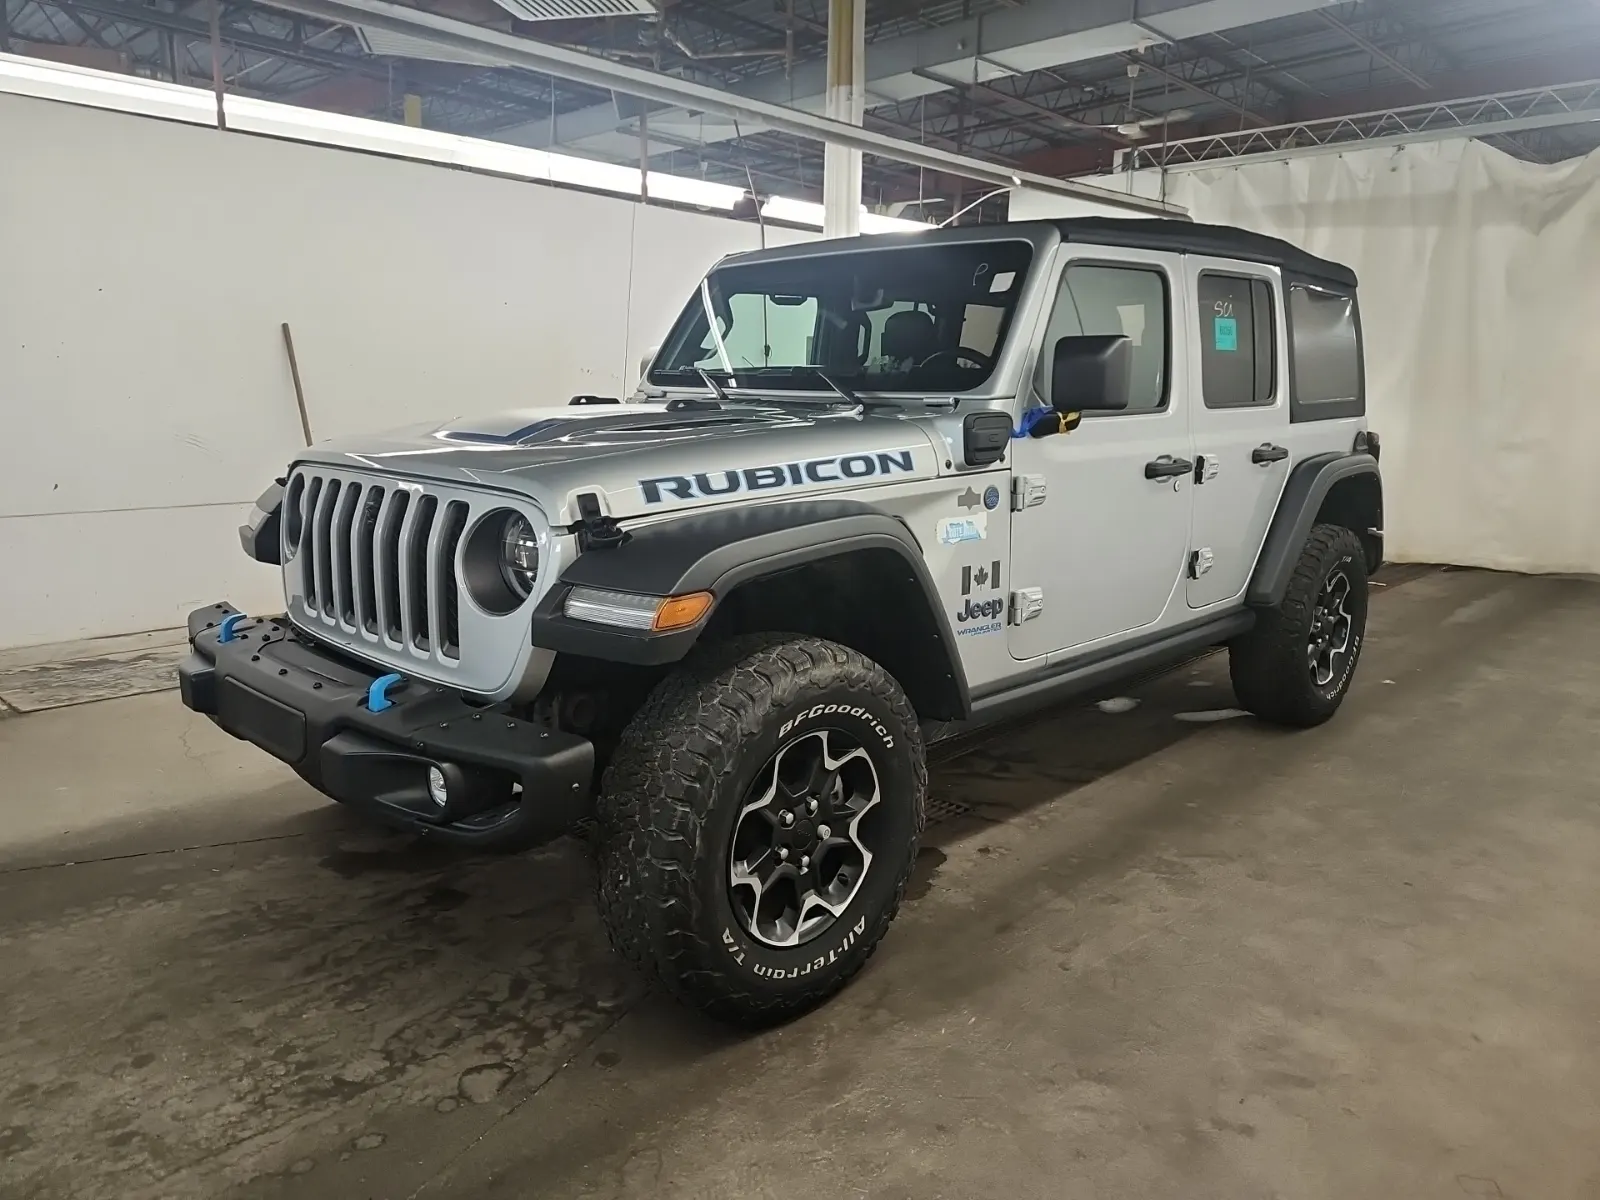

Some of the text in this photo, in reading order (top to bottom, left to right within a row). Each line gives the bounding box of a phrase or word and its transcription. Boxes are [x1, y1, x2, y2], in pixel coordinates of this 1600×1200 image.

[638, 450, 915, 504] RUBICON
[957, 597, 1004, 623] Jeep
[957, 622, 1002, 636] WRANGLER
[1326, 635, 1360, 700] BFGoodrich
[778, 703, 895, 749] BFGoodrich
[721, 914, 866, 980] All-Terrain T/A
